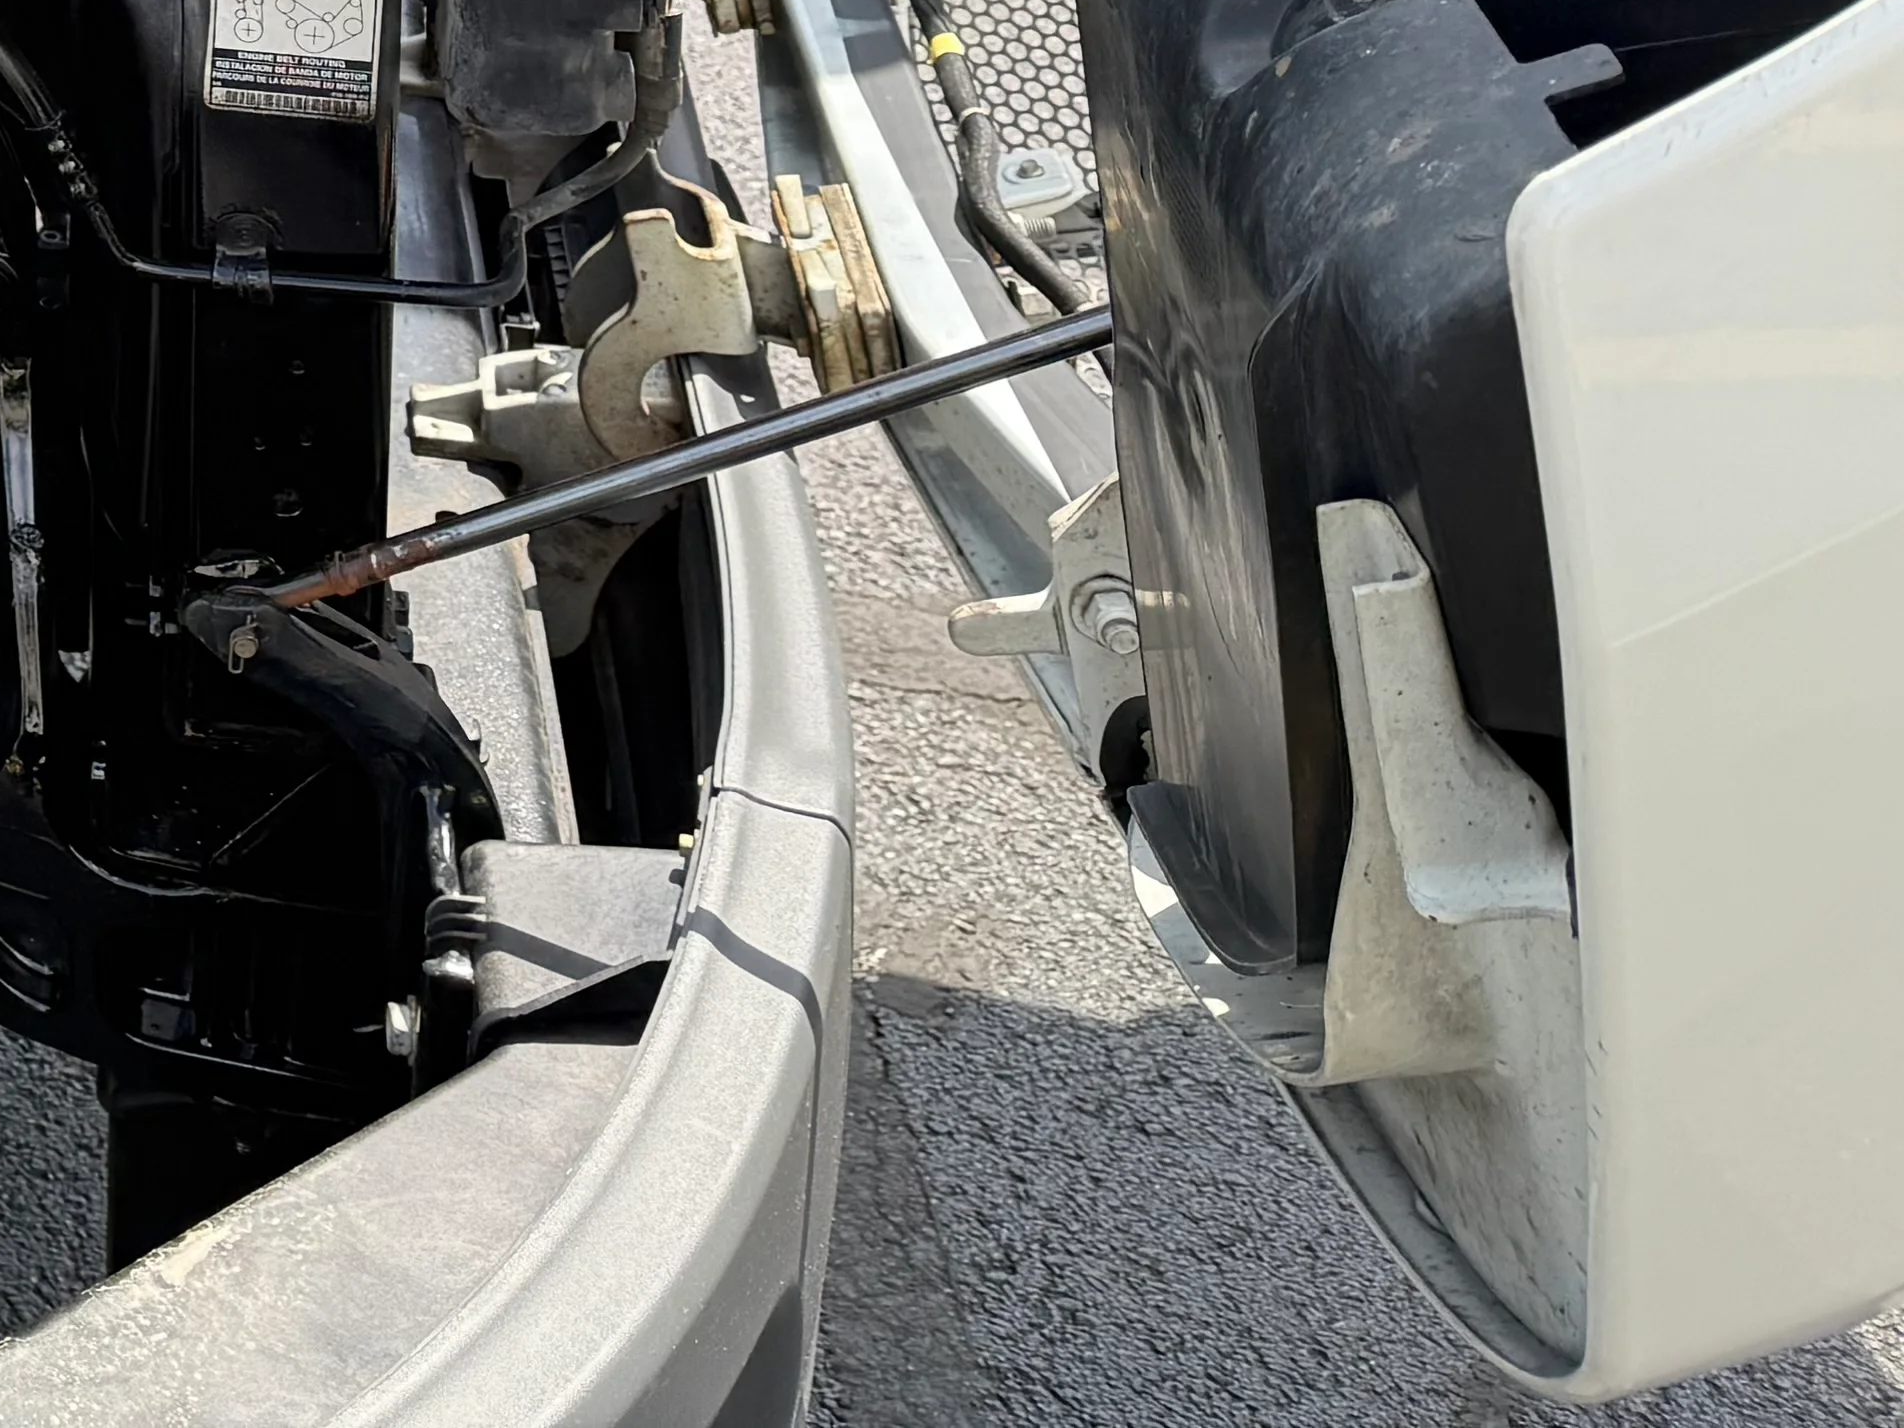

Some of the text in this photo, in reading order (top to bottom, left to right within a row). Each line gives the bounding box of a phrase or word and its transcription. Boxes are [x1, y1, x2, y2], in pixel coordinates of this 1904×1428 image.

[238, 52, 274, 61] ENGINE
[302, 58, 346, 68] ROUTING
[289, 68, 319, 77] BANDA
[335, 72, 368, 81] MOTOR
[336, 83, 370, 92] MOTEUR
